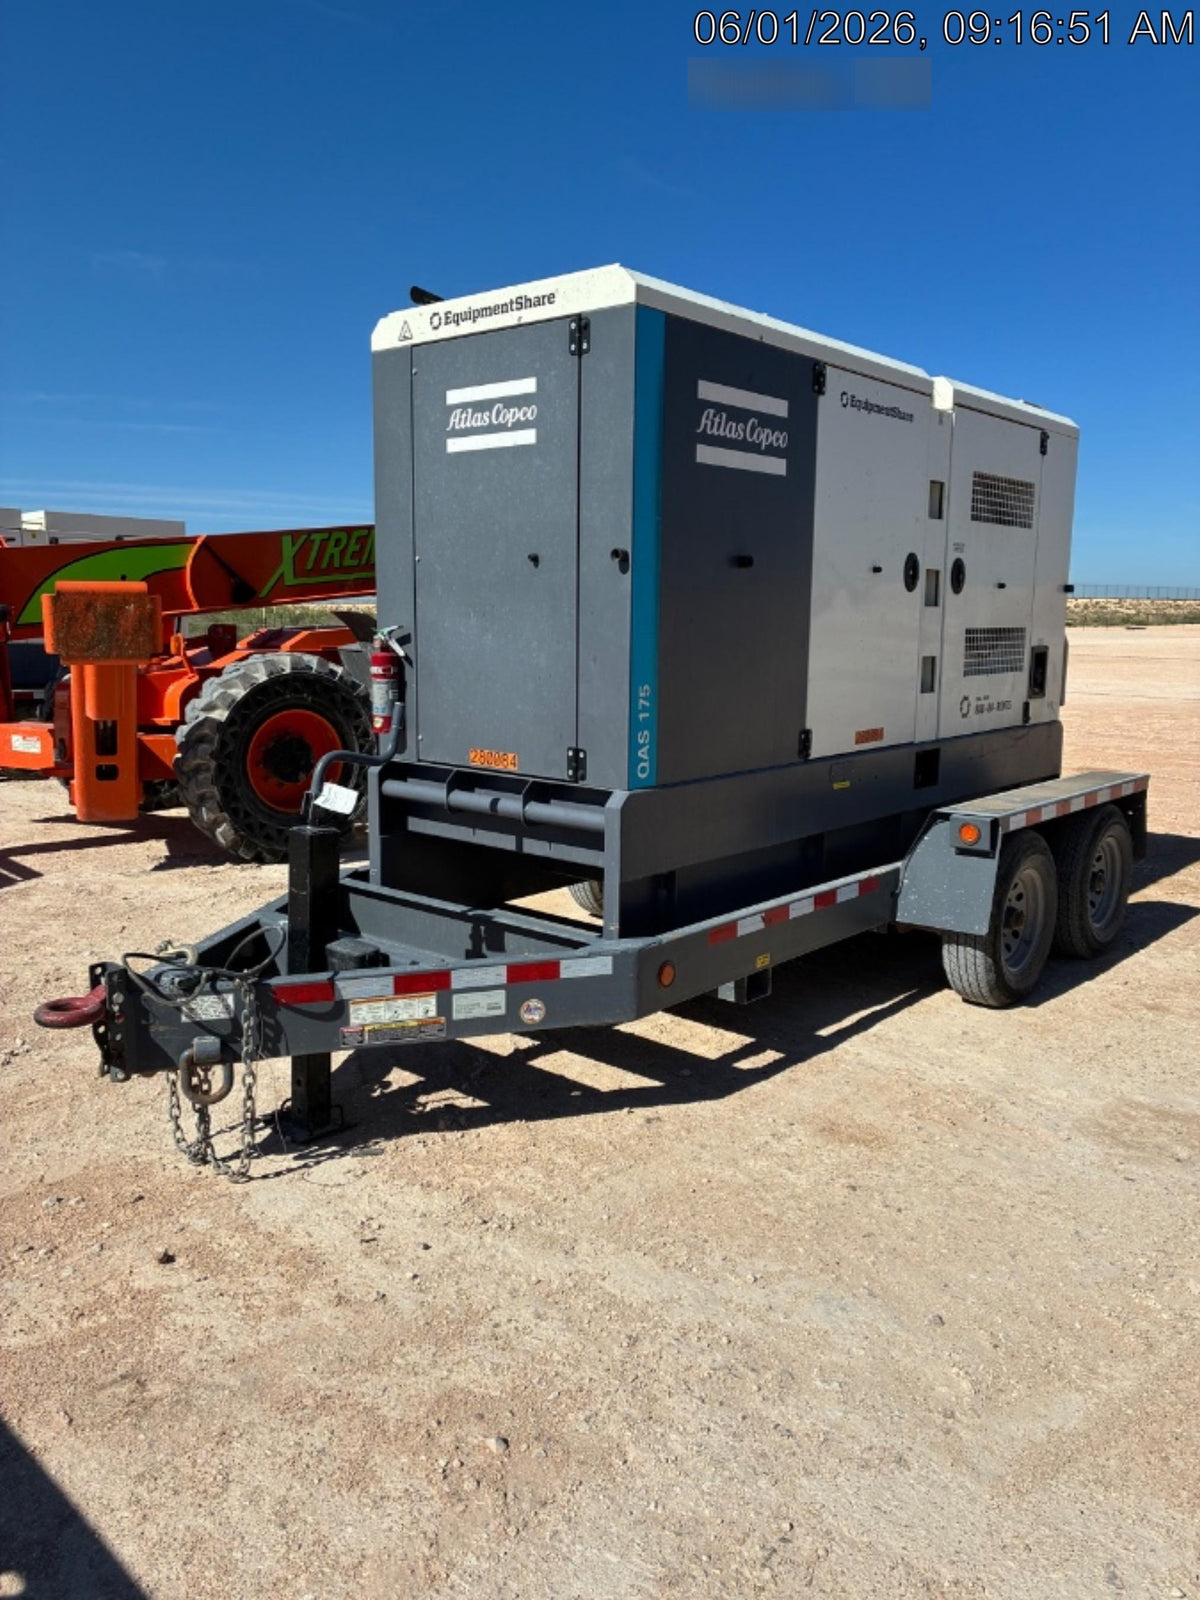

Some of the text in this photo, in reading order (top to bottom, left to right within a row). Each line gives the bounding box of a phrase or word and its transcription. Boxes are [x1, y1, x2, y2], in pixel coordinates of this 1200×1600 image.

[443, 291, 556, 326] EquipmentShare
[445, 403, 538, 431] Atlas Copco
[696, 408, 789, 451] Atlas Copco
[637, 683, 651, 780] QAS 175
